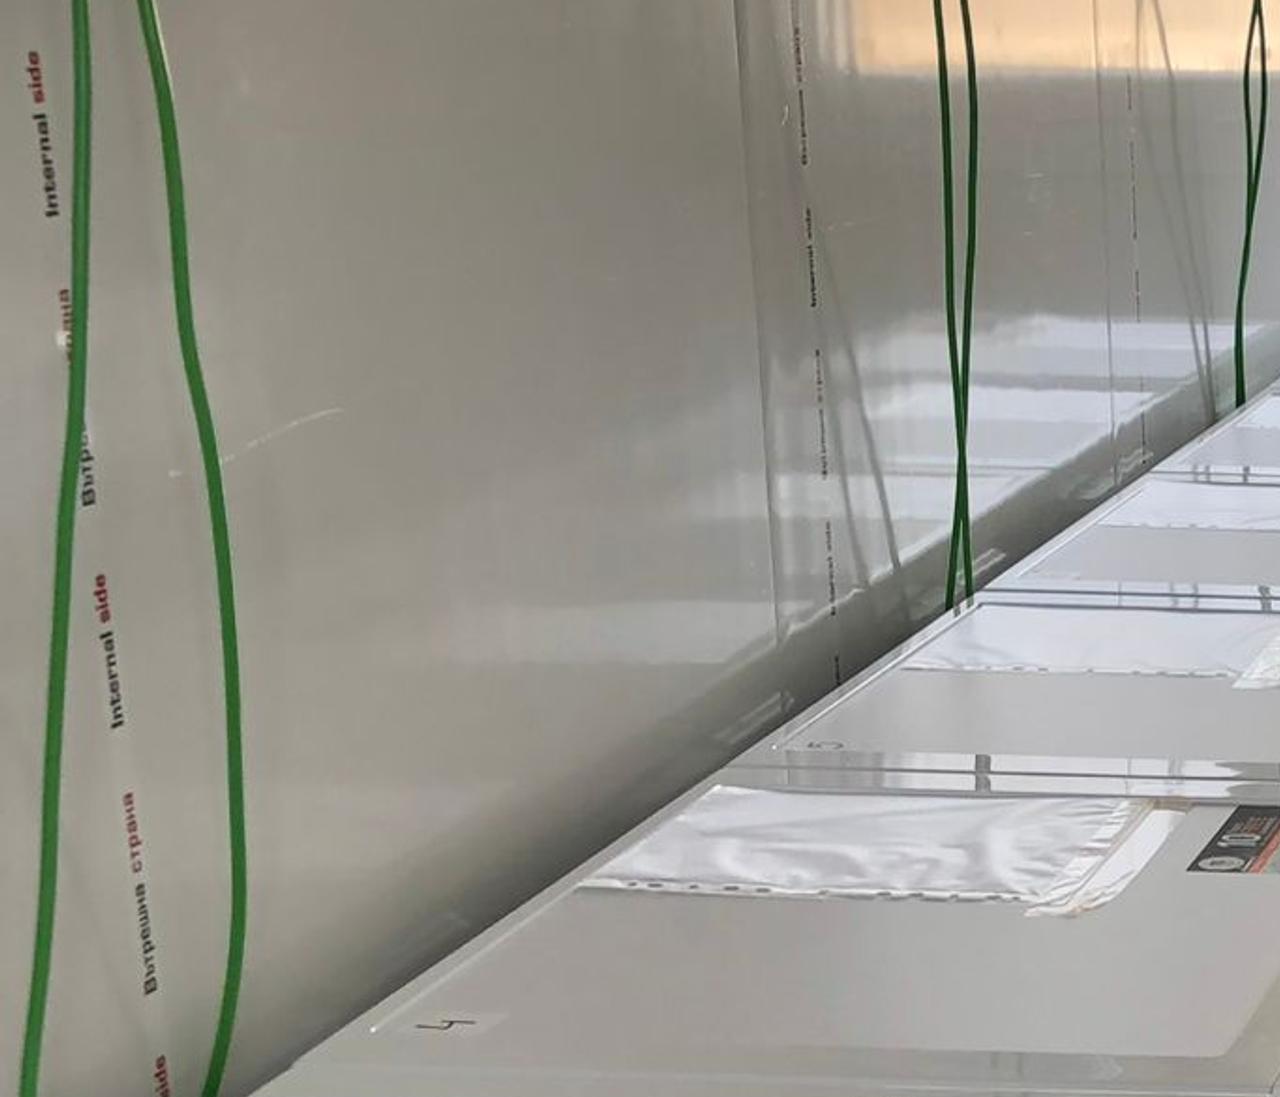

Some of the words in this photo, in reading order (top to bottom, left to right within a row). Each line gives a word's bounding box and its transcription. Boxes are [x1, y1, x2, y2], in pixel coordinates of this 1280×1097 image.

[26, 51, 46, 103] side
[33, 113, 59, 217] Internal
[93, 574, 111, 623] side
[100, 630, 124, 729] Internal
[123, 792, 143, 874] страна
[135, 883, 158, 995] Вътрешна
